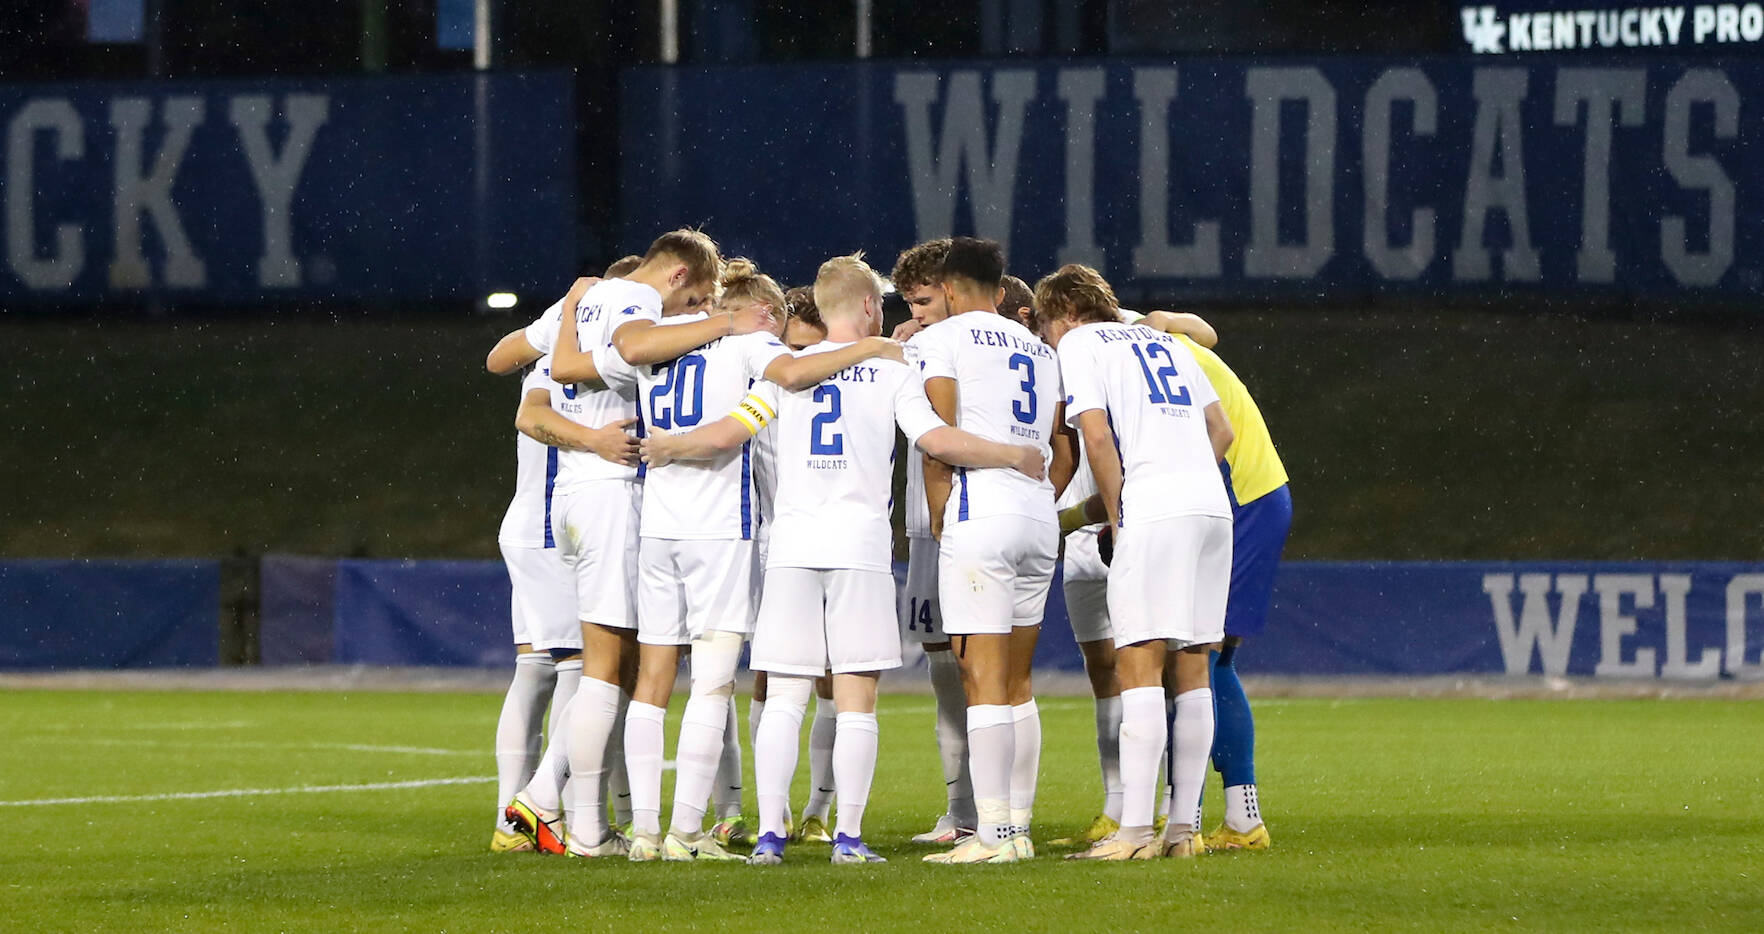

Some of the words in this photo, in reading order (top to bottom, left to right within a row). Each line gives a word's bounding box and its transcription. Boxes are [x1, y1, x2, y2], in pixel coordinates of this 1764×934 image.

[1508, 7, 1686, 51] KENTUCKY
[1693, 3, 1764, 44] PRO
[893, 66, 1744, 288] WILDCATS
[649, 354, 707, 430] 20
[1009, 352, 1037, 425] 3
[1131, 342, 1192, 406] 12
[810, 384, 843, 455] 2
[807, 459, 848, 470] WILDCATS
[909, 596, 934, 633] 14
